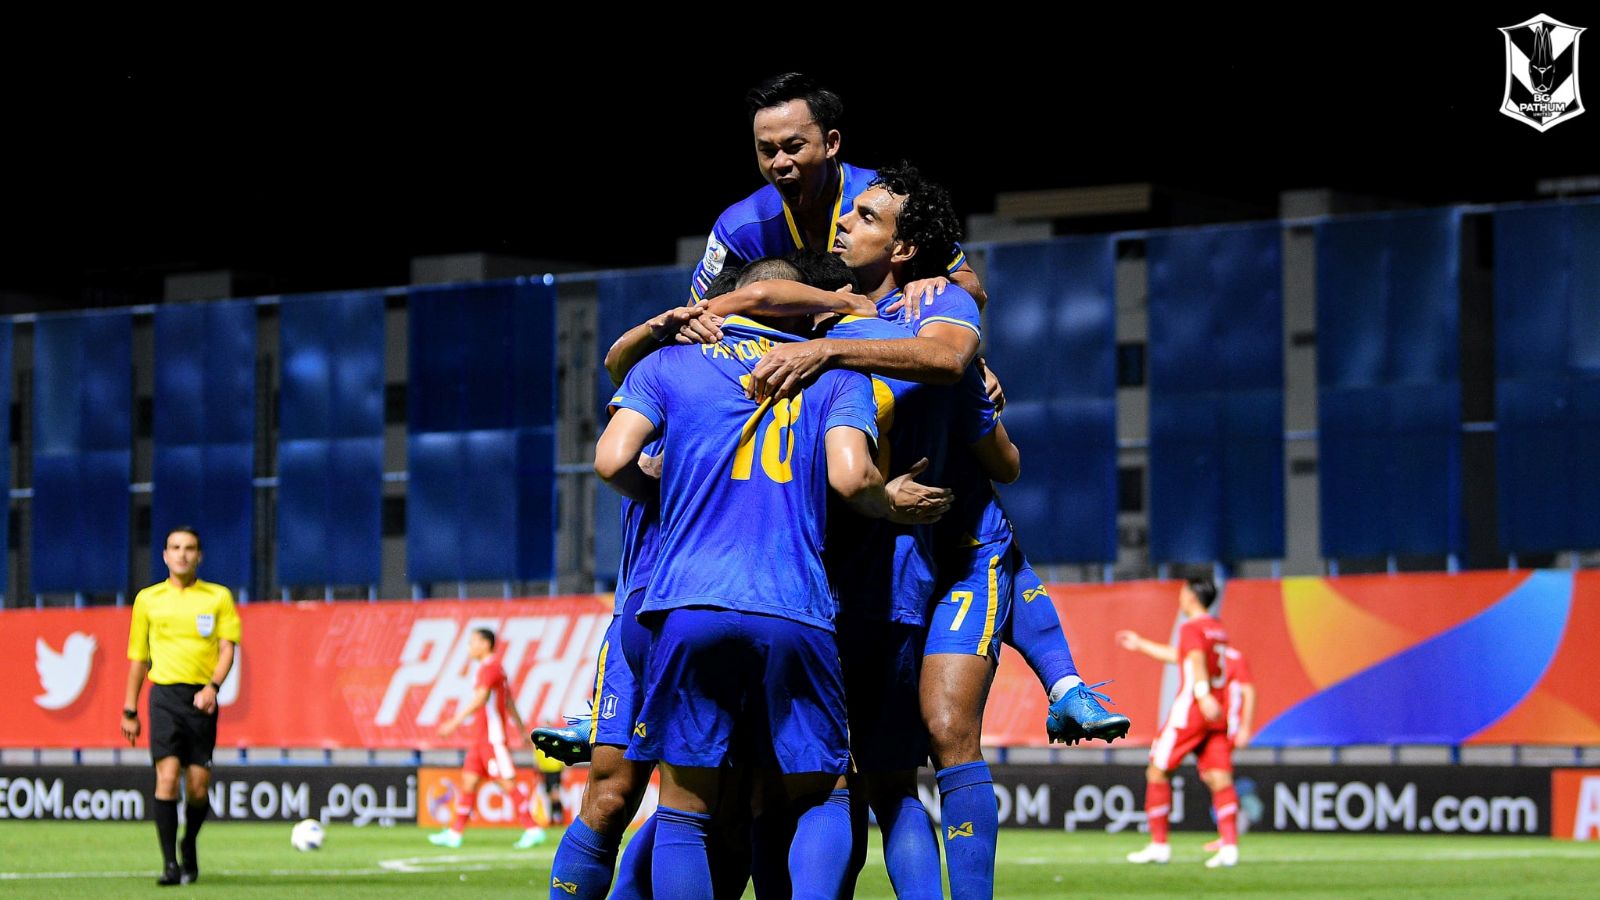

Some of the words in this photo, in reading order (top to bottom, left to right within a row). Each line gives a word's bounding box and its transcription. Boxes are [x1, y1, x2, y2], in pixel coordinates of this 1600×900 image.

[731, 374, 803, 484] 18
[950, 591, 974, 631] 7
[1273, 781, 1538, 833] NEOM.com
